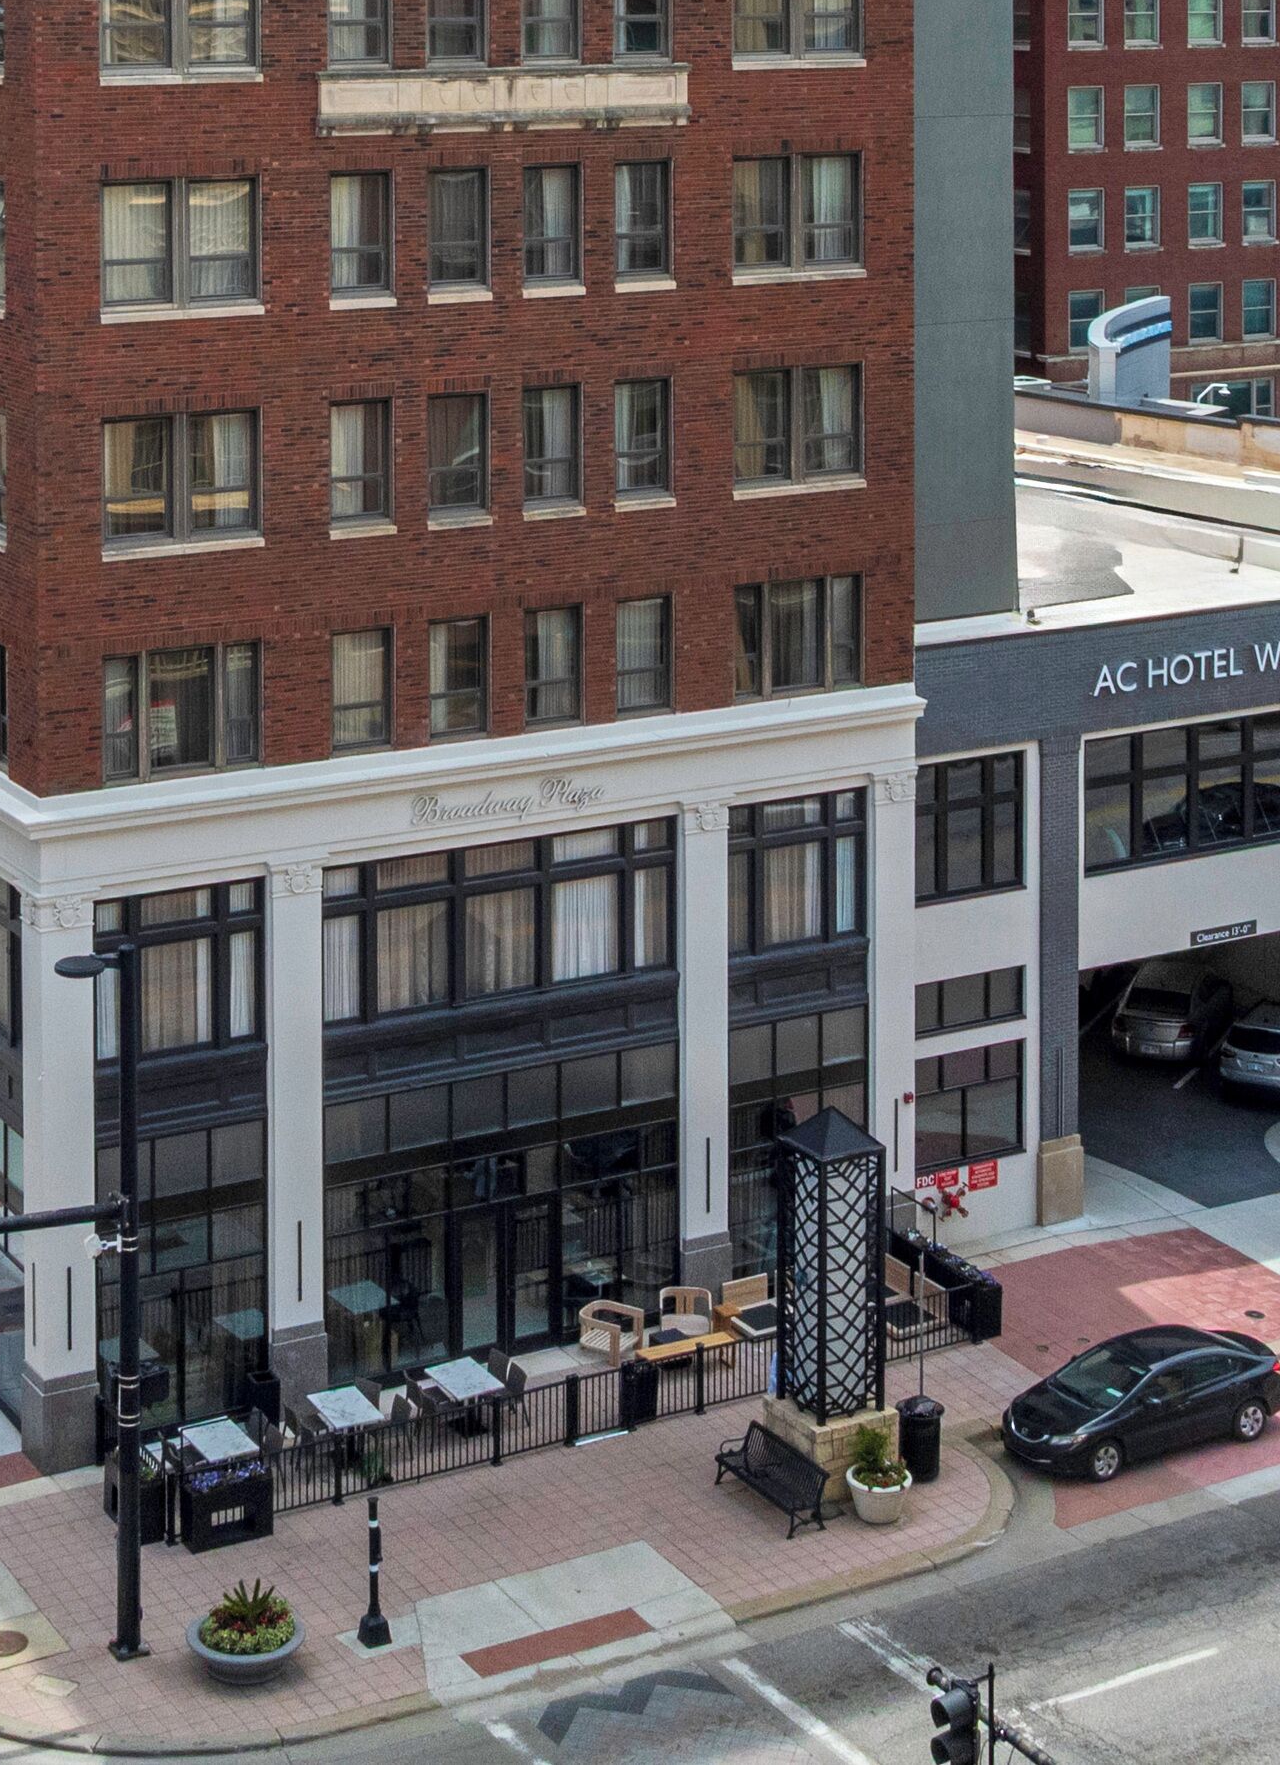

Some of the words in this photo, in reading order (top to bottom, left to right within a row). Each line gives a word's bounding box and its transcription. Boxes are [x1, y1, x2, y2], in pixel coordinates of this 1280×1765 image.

[1094, 661, 1138, 697] AC
[1148, 647, 1244, 689] HOTEL
[411, 791, 534, 826] Broadway
[539, 778, 606, 811] Plaza
[916, 1174, 936, 1188] FDC
